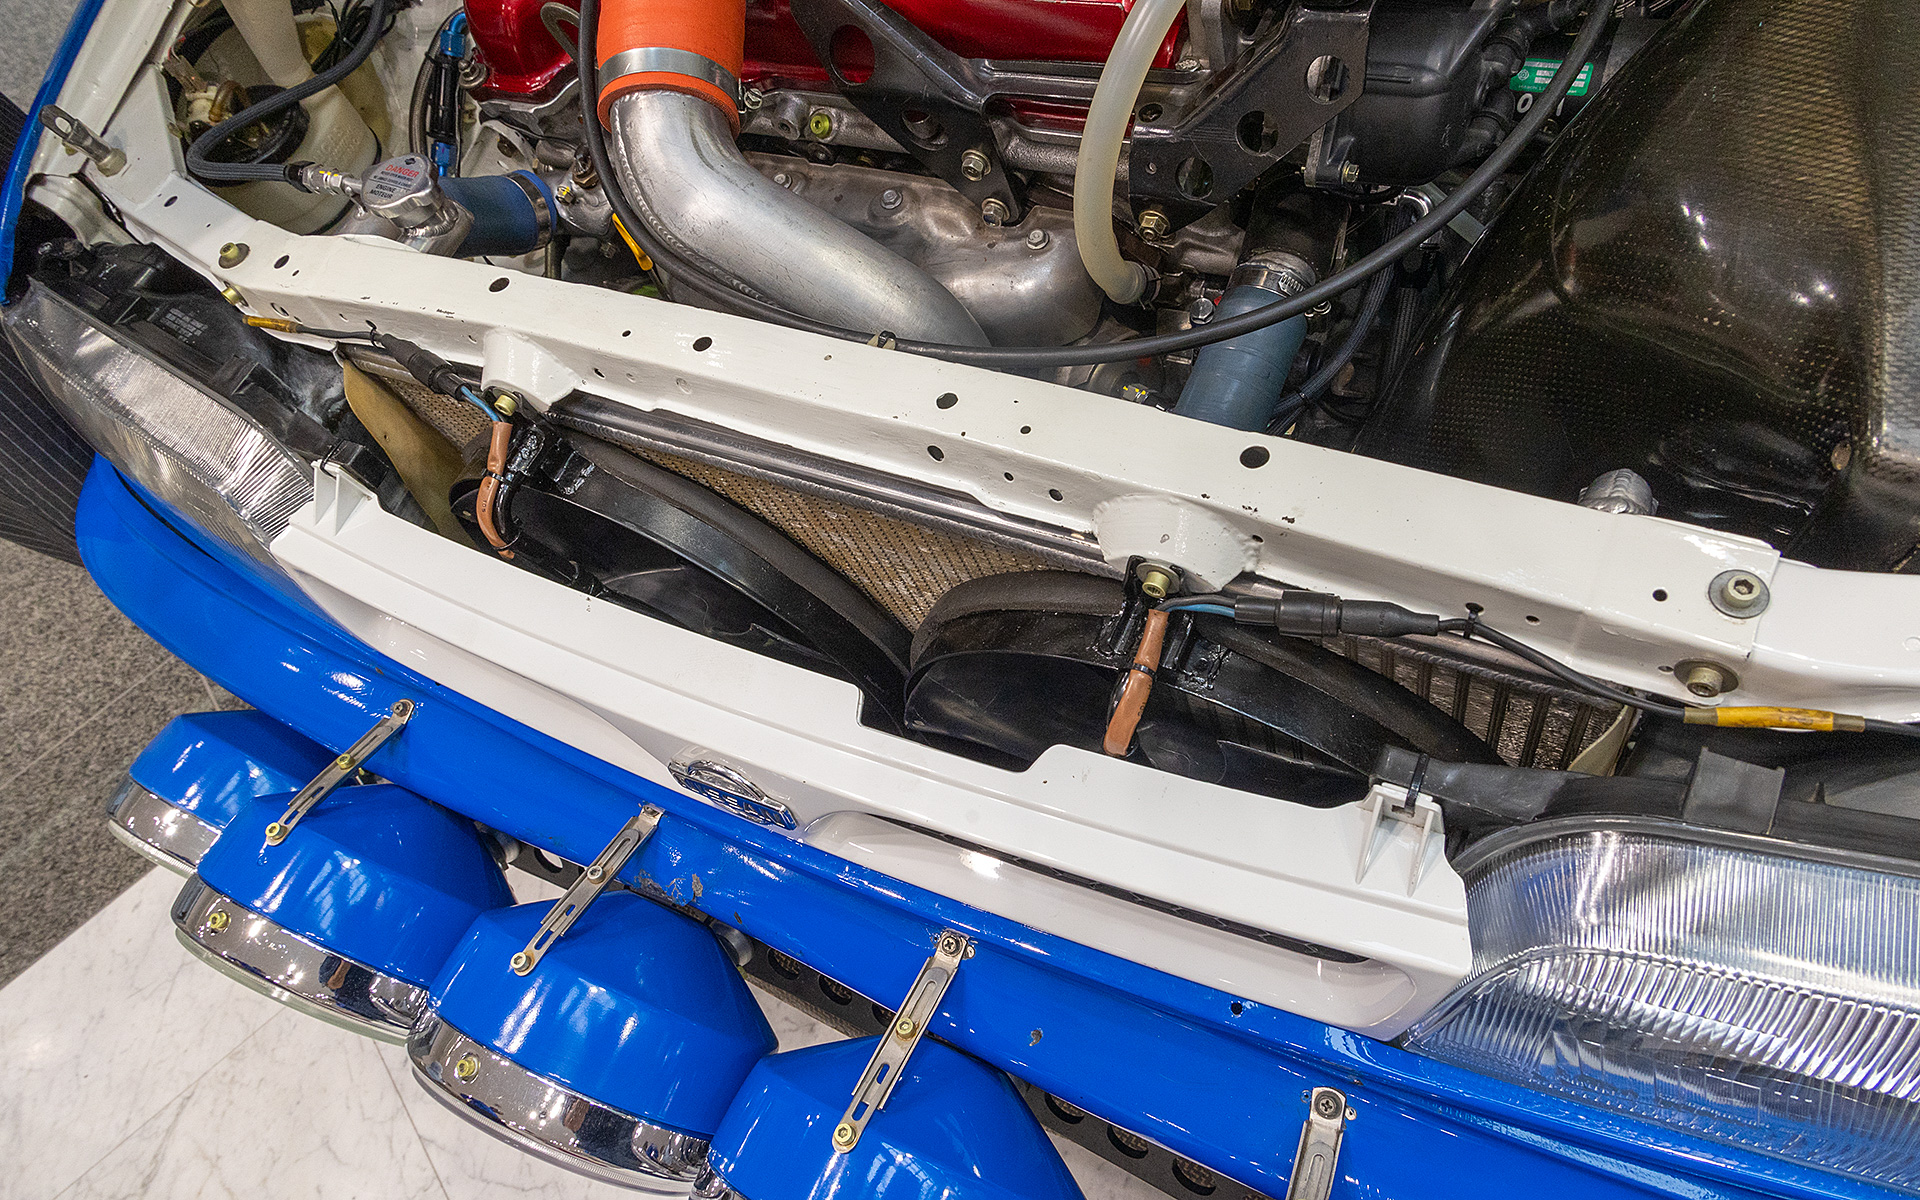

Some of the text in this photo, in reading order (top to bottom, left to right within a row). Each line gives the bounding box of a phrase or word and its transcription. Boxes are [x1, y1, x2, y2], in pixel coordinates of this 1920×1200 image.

[385, 165, 419, 178] DANGER
[376, 184, 396, 193] ENGINE
[370, 190, 393, 199] MOTEUR
